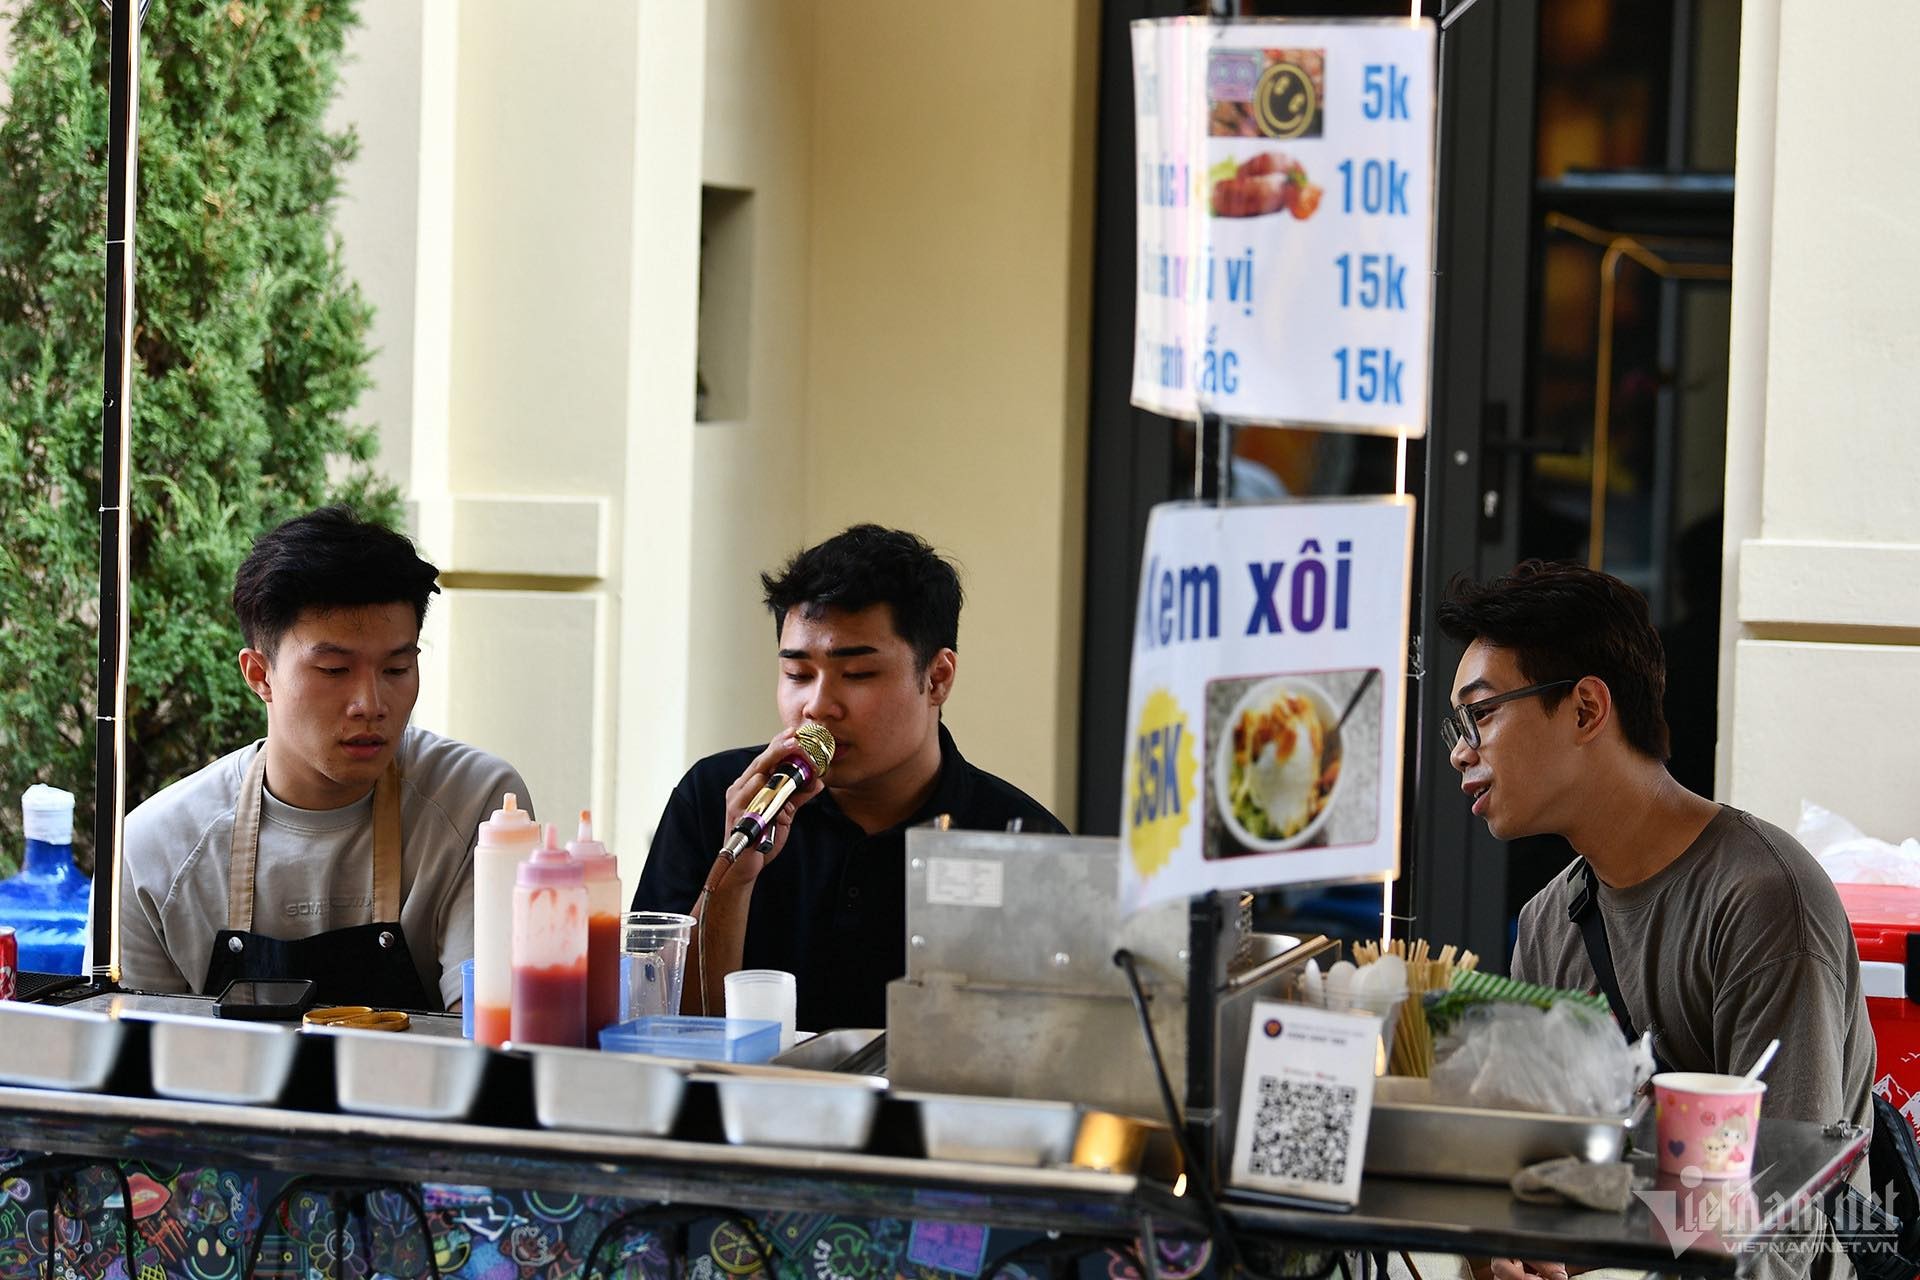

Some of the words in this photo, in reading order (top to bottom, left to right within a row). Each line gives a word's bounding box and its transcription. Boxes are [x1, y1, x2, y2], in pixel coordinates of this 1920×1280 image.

[1363, 64, 1410, 120] 5k
[1337, 158, 1410, 216] 10k
[1225, 246, 1254, 317] vị
[1334, 252, 1408, 311] 15k
[1333, 346, 1406, 405] 15k
[1245, 537, 1354, 636] xôi
